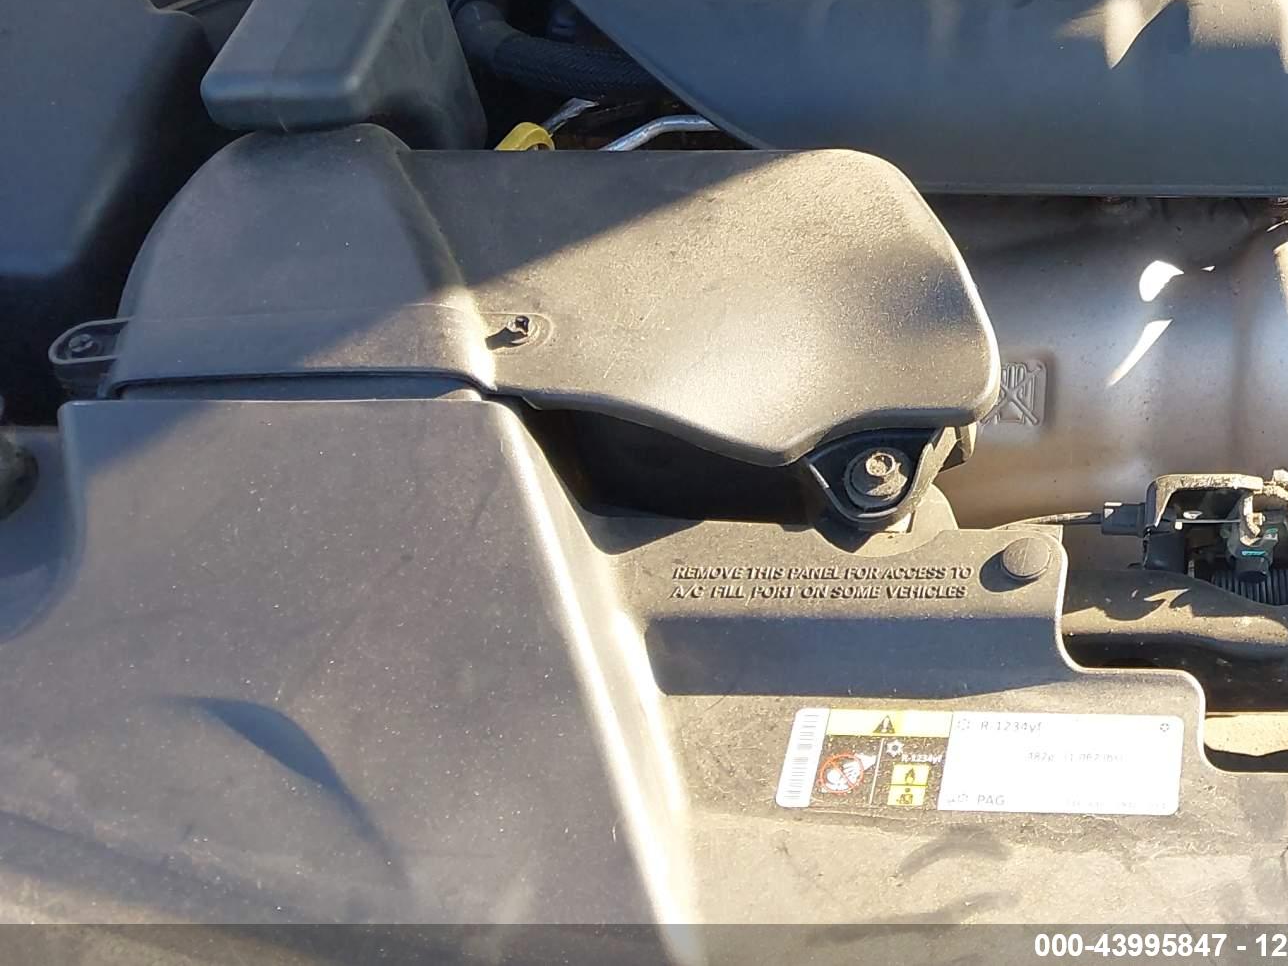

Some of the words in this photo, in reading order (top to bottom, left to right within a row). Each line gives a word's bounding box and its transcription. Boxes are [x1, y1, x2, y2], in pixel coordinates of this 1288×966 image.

[672, 565, 744, 581] REMOVE
[745, 565, 785, 581] THIS
[787, 565, 841, 581] PANEL
[844, 565, 880, 581] FOR
[880, 565, 948, 581] ACCESS
[949, 565, 974, 581] TO
[670, 584, 705, 600] A/C
[710, 584, 745, 600] FILL
[750, 584, 796, 600] PORT
[801, 584, 828, 600] ON
[830, 584, 881, 600] SOME
[885, 584, 967, 600] VEHICLES
[977, 793, 1006, 807] PAG
